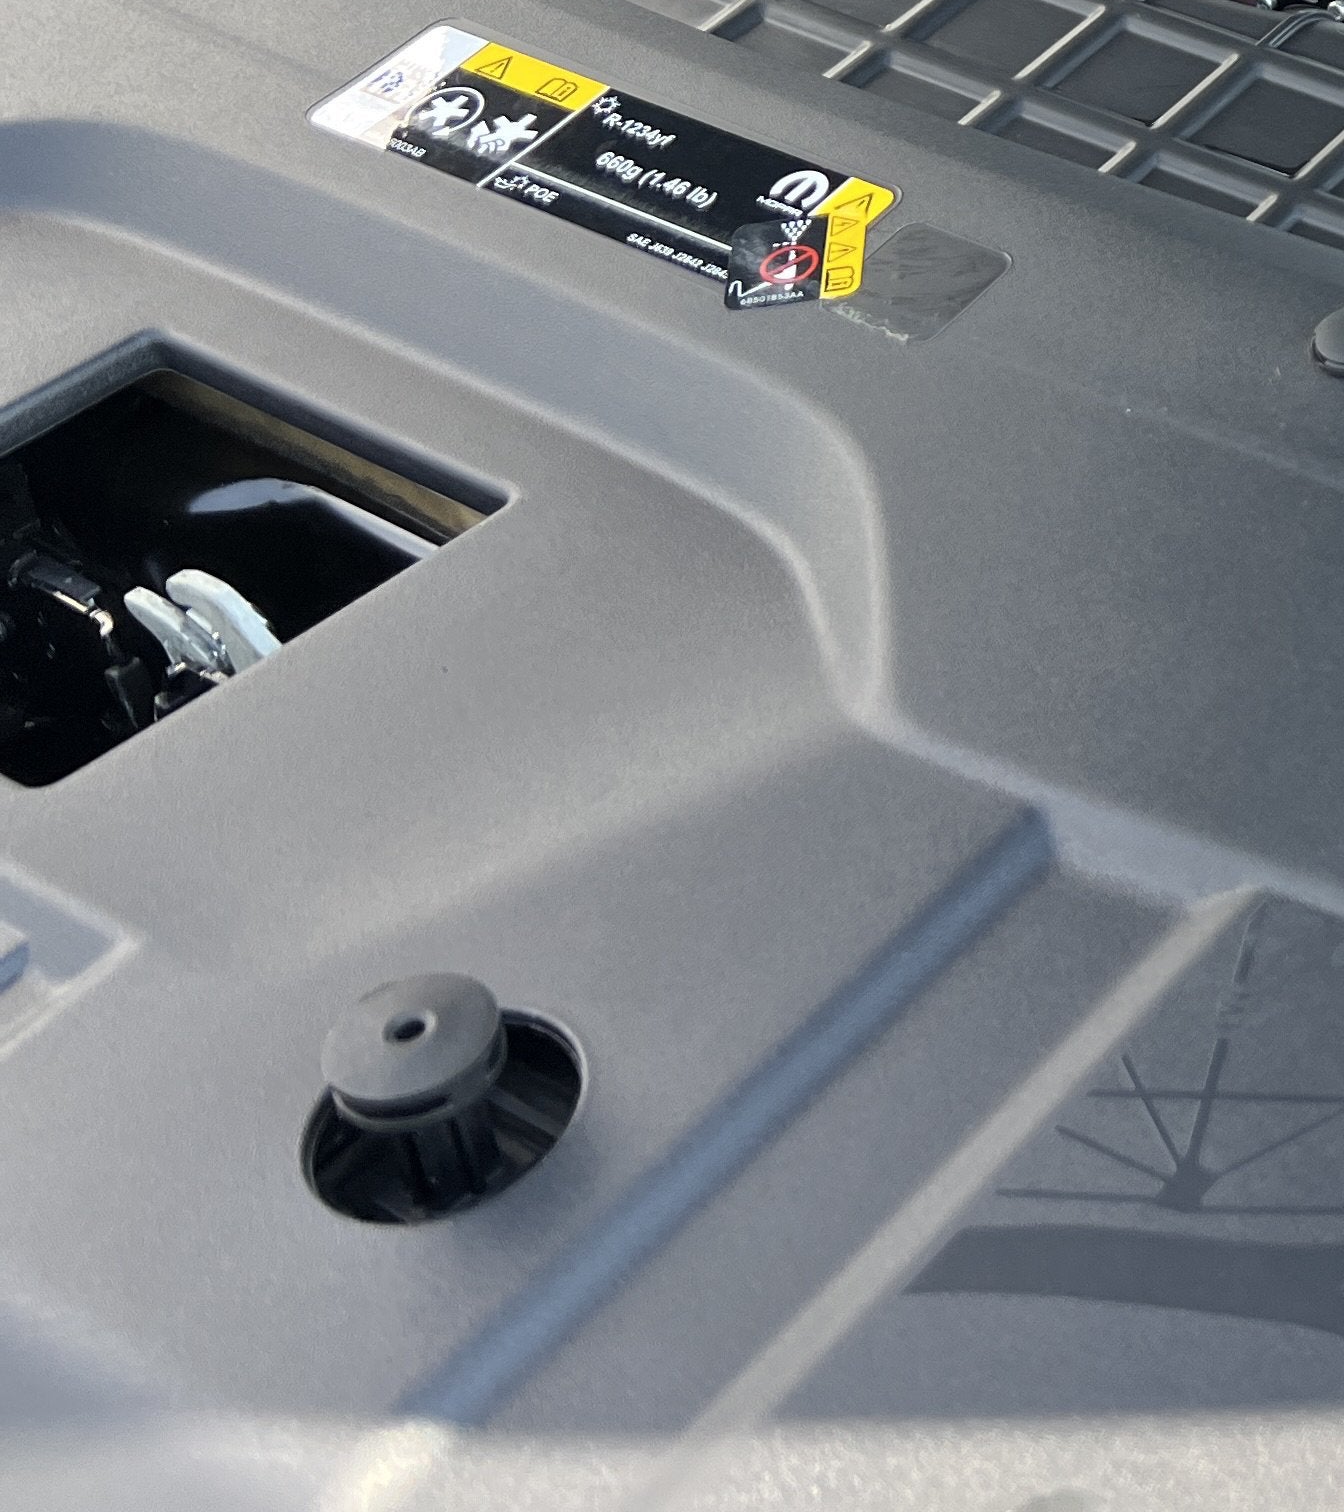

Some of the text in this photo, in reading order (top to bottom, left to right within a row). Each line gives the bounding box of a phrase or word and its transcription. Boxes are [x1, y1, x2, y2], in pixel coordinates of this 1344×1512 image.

[602, 112, 677, 148] R-1234yf
[524, 184, 559, 203] POE
[595, 151, 718, 209] 660g (1.46 lb)
[626, 232, 652, 248] SAE
